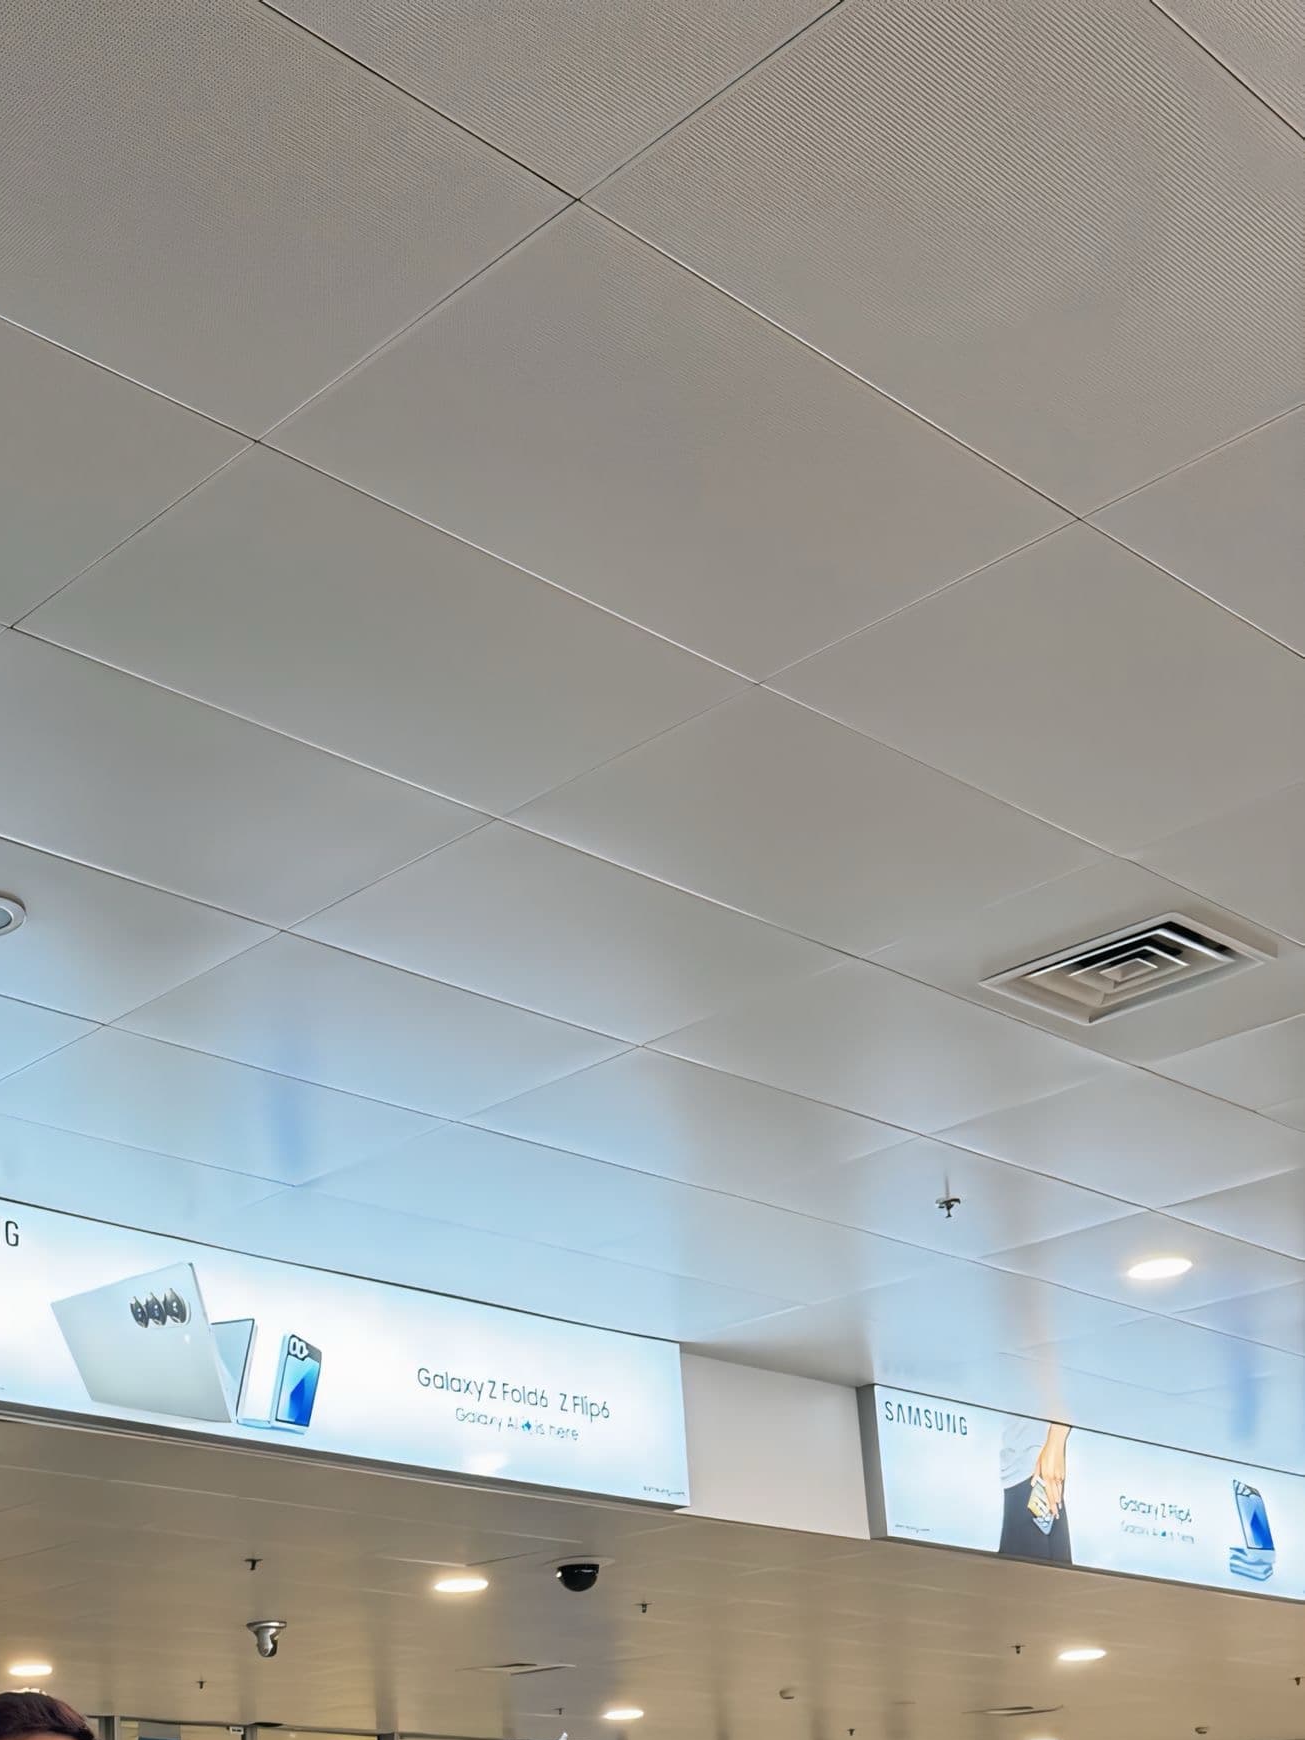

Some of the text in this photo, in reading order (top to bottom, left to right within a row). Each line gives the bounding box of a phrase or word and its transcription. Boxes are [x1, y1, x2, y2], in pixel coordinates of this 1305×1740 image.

[417, 1367, 611, 1423] Galaxy Z Fold6 Z Flip6
[884, 1400, 968, 1436] SAMSUNG
